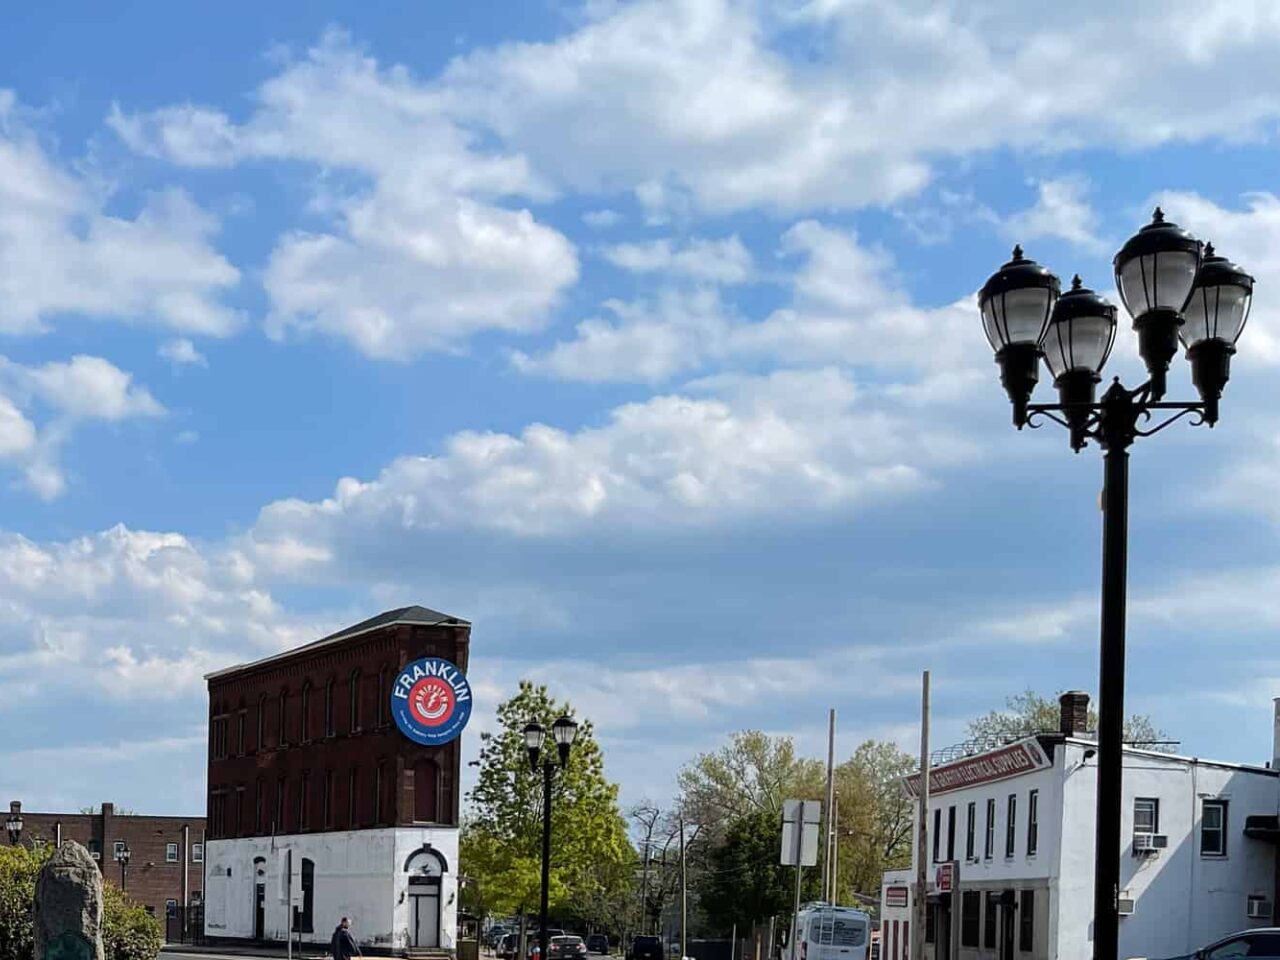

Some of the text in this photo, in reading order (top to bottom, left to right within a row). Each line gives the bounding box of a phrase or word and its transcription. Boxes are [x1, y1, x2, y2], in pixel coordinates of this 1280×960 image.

[394, 661, 470, 702] FRANKLIN
[960, 760, 997, 782] ELECTRICAL
[992, 750, 1029, 773] SUPPLIES
